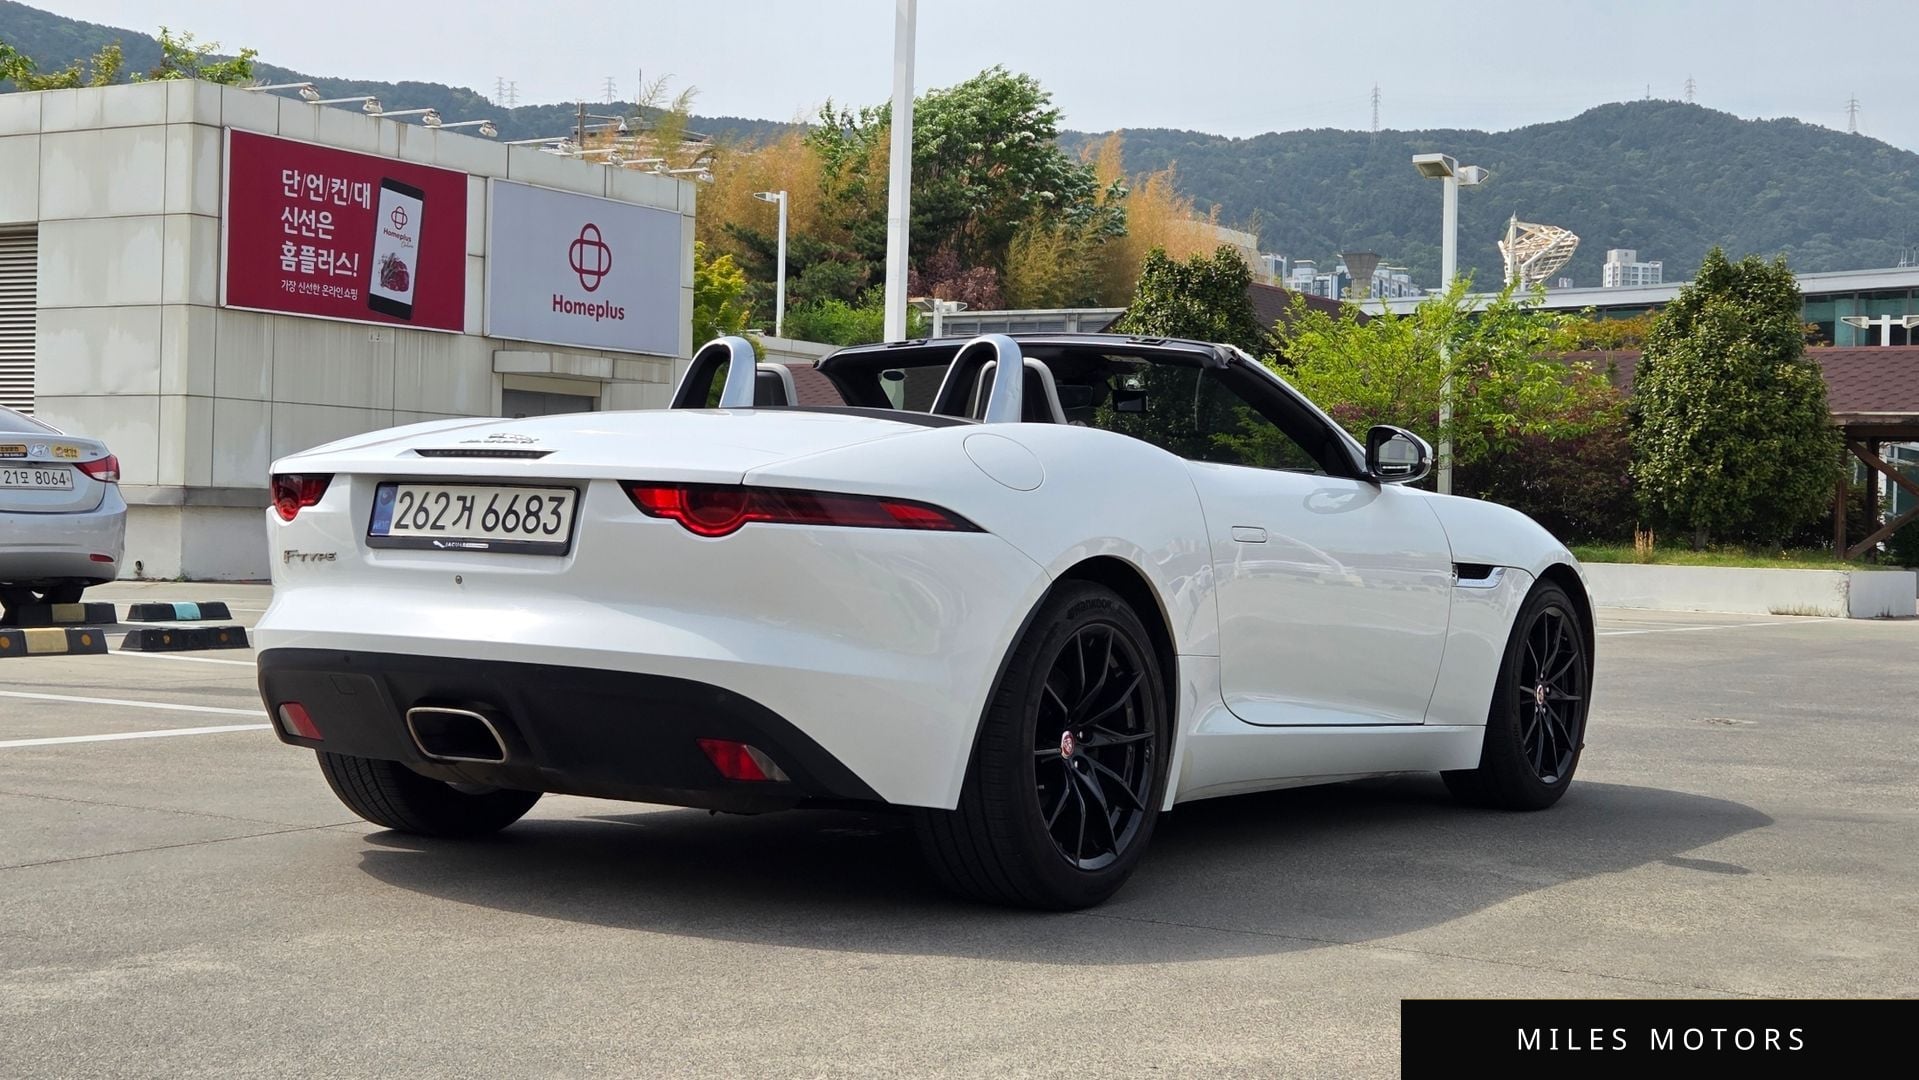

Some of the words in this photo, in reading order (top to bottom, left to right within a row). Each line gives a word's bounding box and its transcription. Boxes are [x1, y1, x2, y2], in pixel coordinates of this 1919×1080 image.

[282, 169, 371, 210] 단/언/컨/대
[281, 206, 335, 240] 신선은
[280, 240, 359, 278] 홈플러스!
[281, 279, 297, 293] 가장
[298, 281, 321, 296] 신선한
[552, 293, 625, 322] Homeplus
[3, 470, 29, 485] 21모
[34, 471, 66, 486] 8064
[481, 492, 566, 535] 6683
